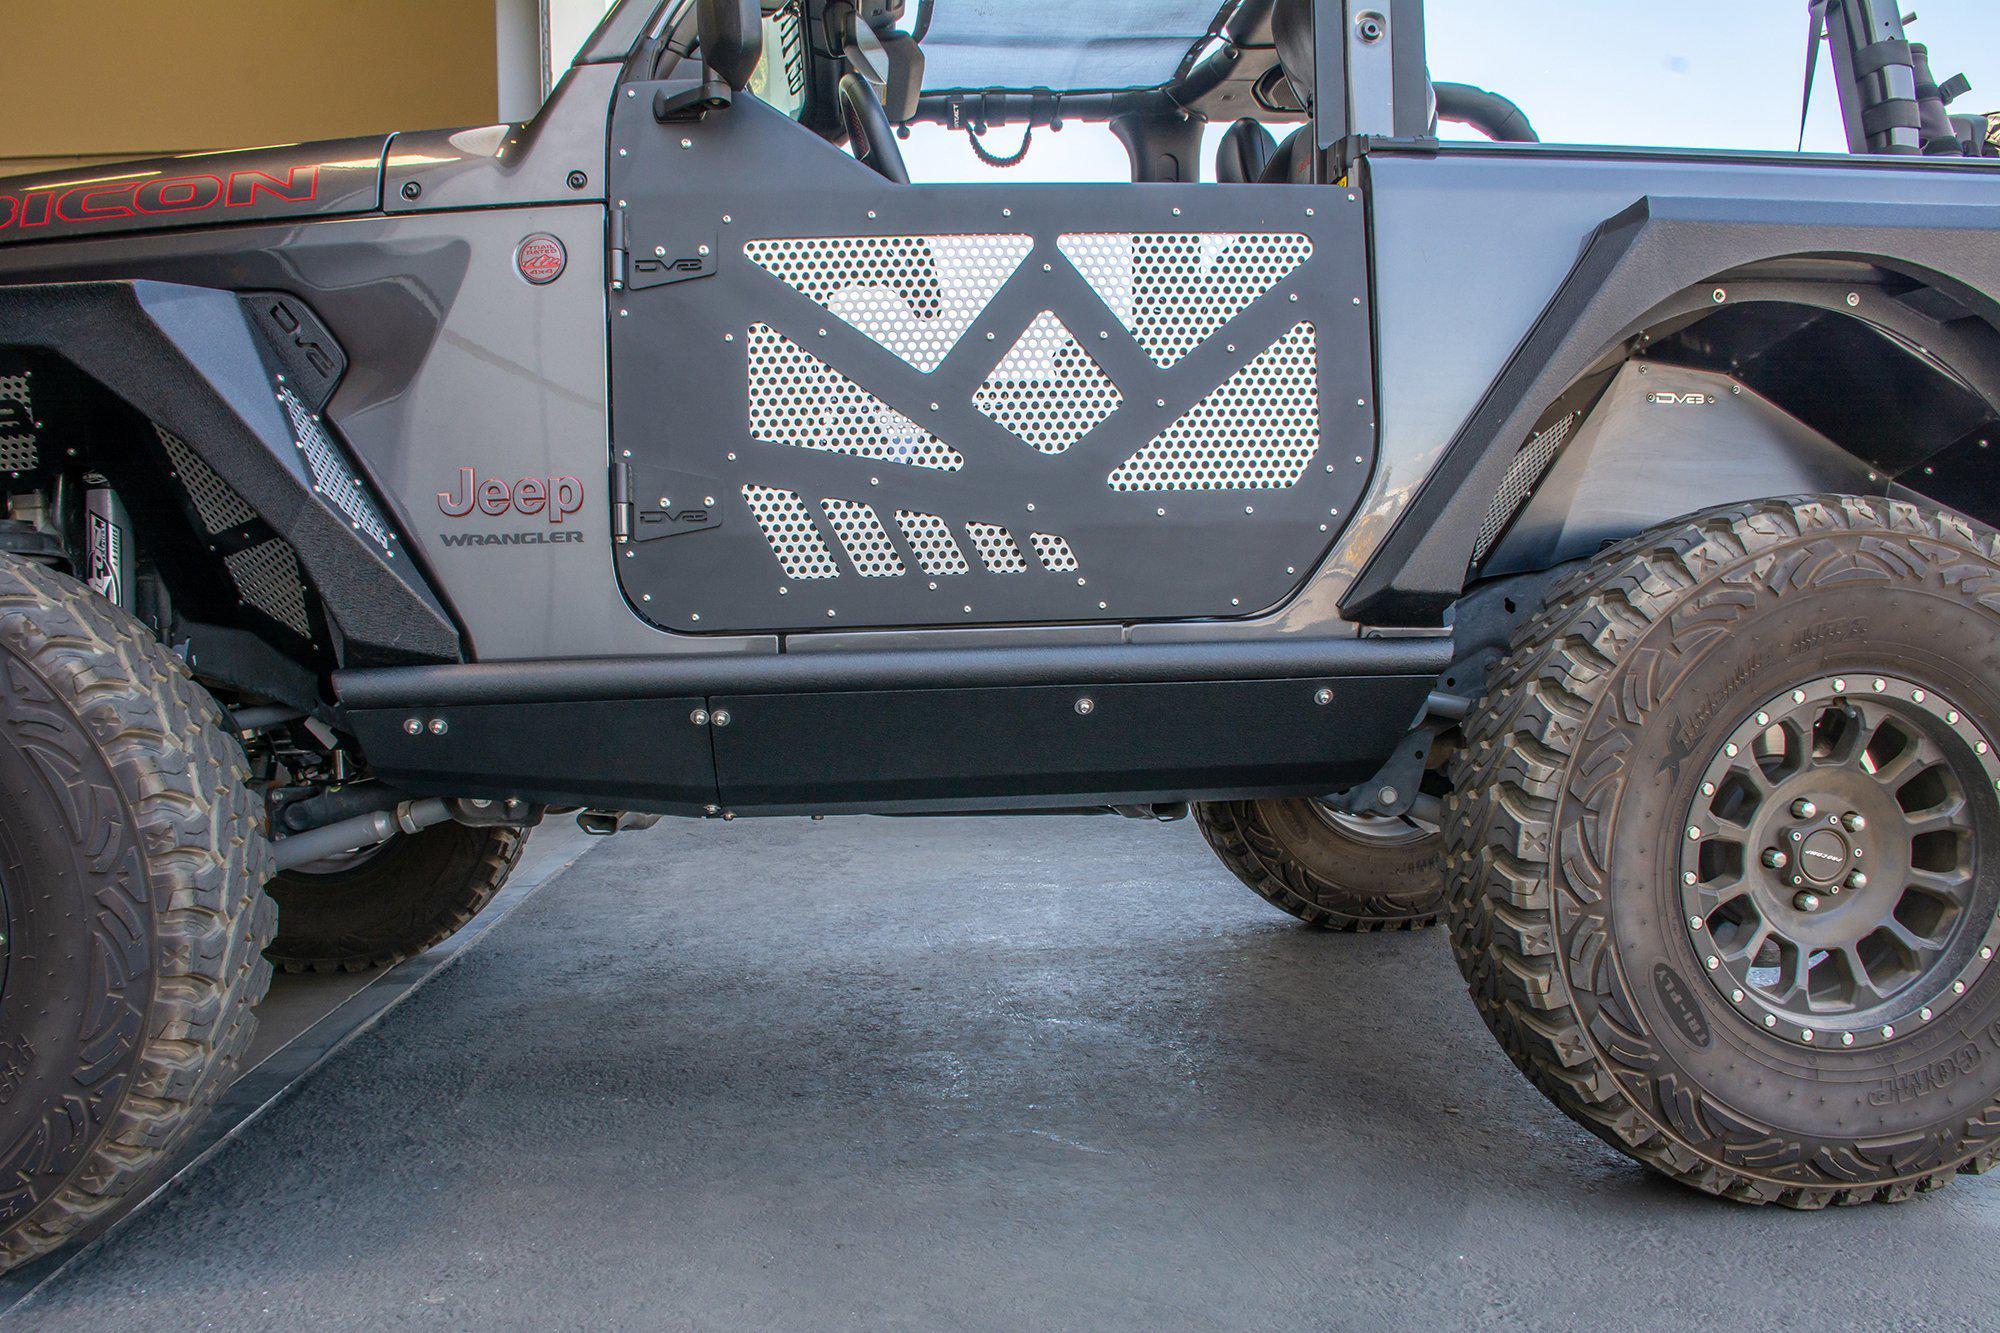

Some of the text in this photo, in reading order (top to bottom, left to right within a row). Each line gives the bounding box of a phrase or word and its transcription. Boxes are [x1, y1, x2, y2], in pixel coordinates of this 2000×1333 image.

[0, 165, 319, 229] ICON
[437, 467, 585, 523] Jeep
[440, 531, 585, 547] WRANGLER
